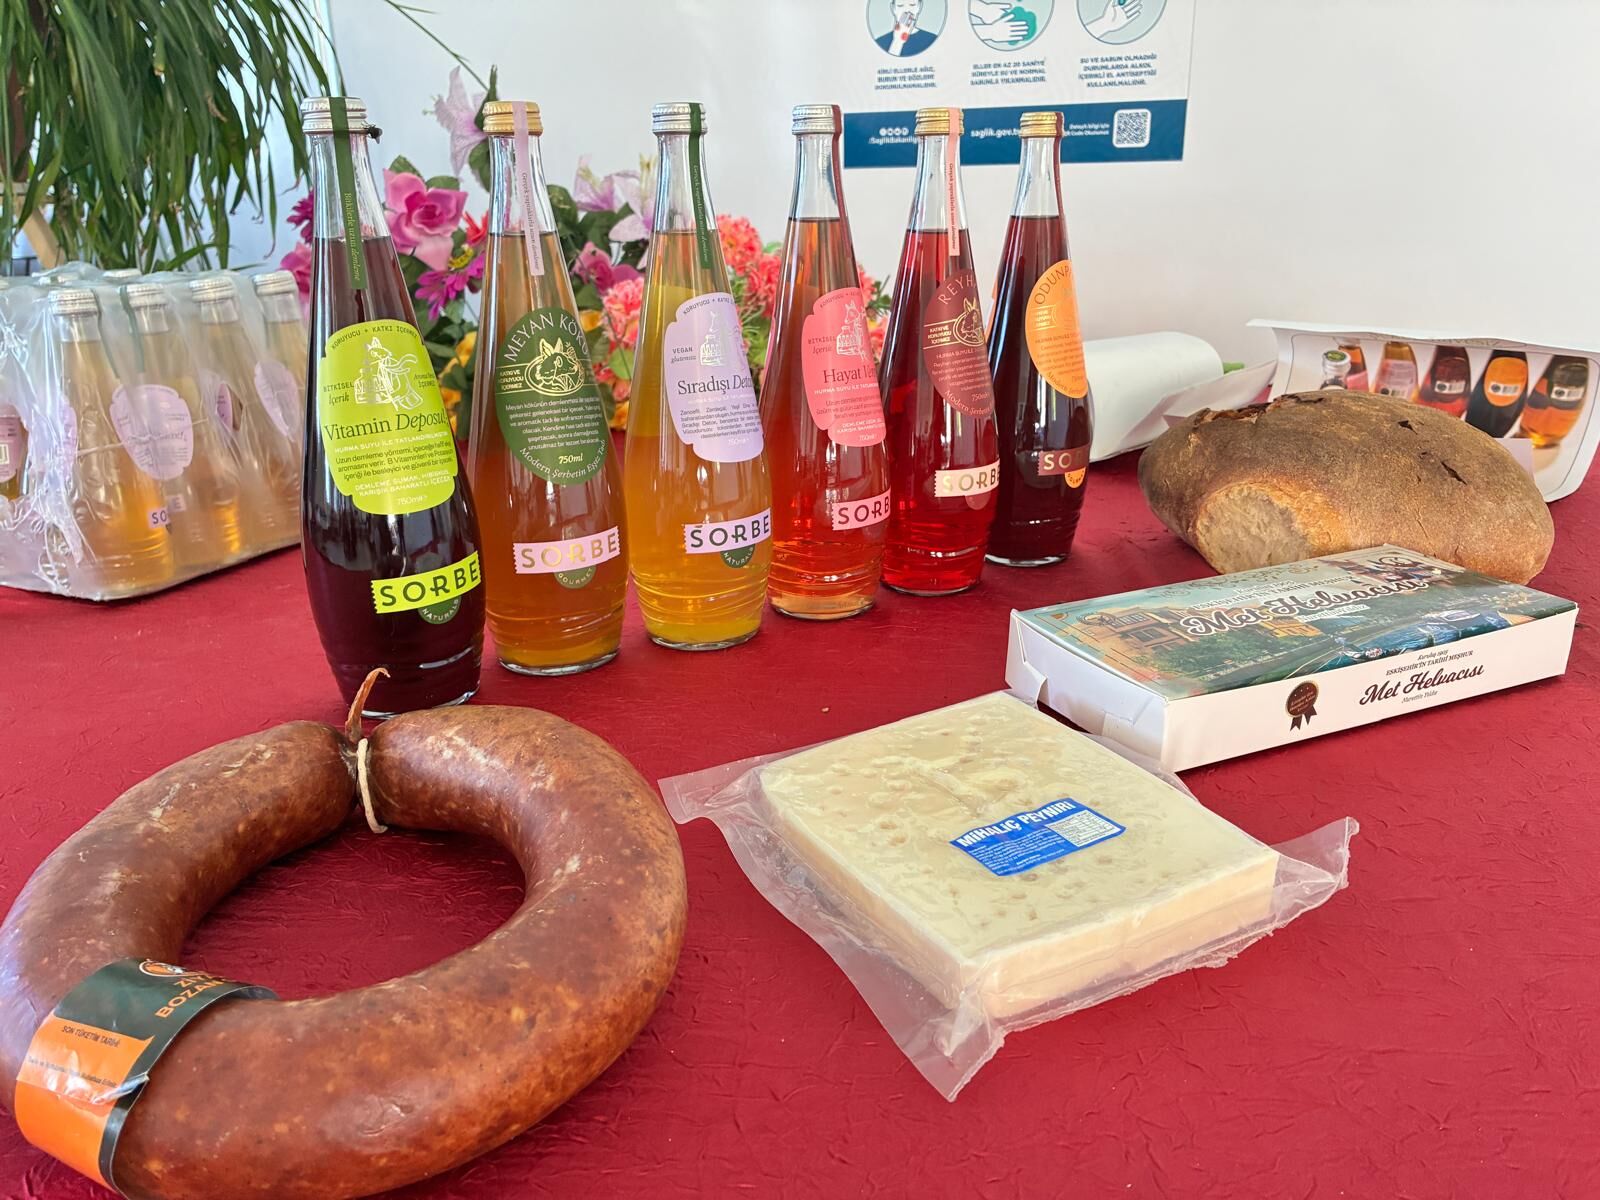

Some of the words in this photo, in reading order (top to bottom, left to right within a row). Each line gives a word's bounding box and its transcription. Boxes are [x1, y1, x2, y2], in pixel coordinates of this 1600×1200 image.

[868, 136, 918, 146] /SaglikBakanlig
[970, 127, 1021, 139] saglik.gov.t
[937, 274, 976, 305] REYH
[503, 312, 554, 362] MEYAN
[672, 346, 693, 354] VEGAN
[677, 375, 730, 395] Sıradışı
[823, 368, 861, 384] Hayat
[324, 417, 392, 441] Vitamin
[336, 456, 352, 464] Uzun
[352, 451, 384, 462] demleme
[387, 457, 393, 465] B
[520, 447, 551, 474] Modern
[552, 468, 587, 479] Şerbetin
[559, 453, 584, 465] 750ml
[838, 496, 890, 525] SORB
[690, 515, 770, 548] SORBE
[521, 533, 617, 569] SORBE
[380, 561, 479, 607] SORBE
[1180, 607, 1273, 636] Met
[1359, 680, 1401, 705] Met
[1402, 665, 1485, 693] Helvacısı
[62, 1025, 74, 1034] SON
